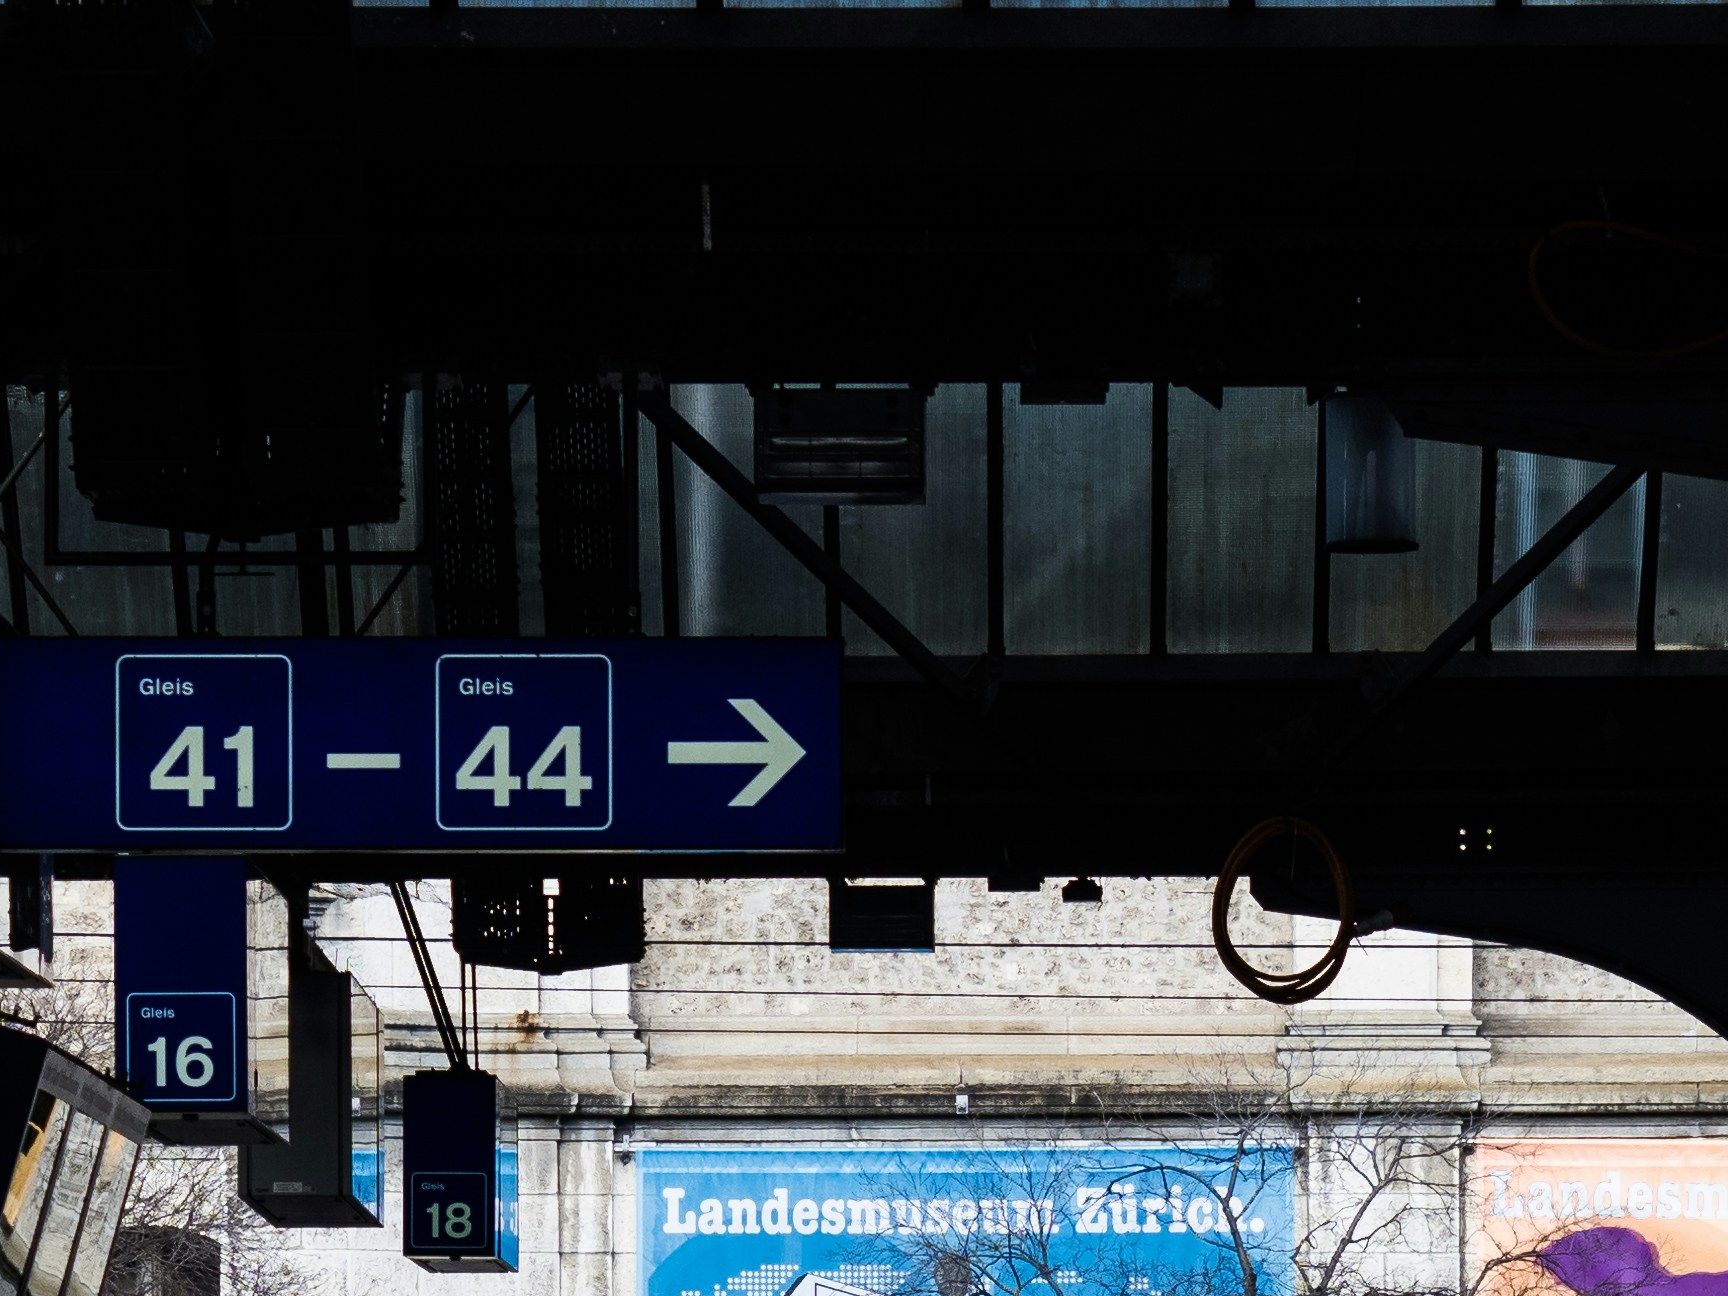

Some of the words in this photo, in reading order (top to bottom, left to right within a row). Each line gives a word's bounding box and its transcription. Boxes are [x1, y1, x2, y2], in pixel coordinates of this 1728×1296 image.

[139, 678, 194, 696] Gleis
[459, 677, 514, 695] Gleis
[148, 725, 254, 808] 41
[455, 725, 593, 807] 44
[141, 1007, 175, 1019] Gleis
[147, 1035, 214, 1088] 16
[420, 1182, 446, 1191] Gleis
[426, 1201, 473, 1239] 18
[662, 1186, 1060, 1235] Landesmuseum
